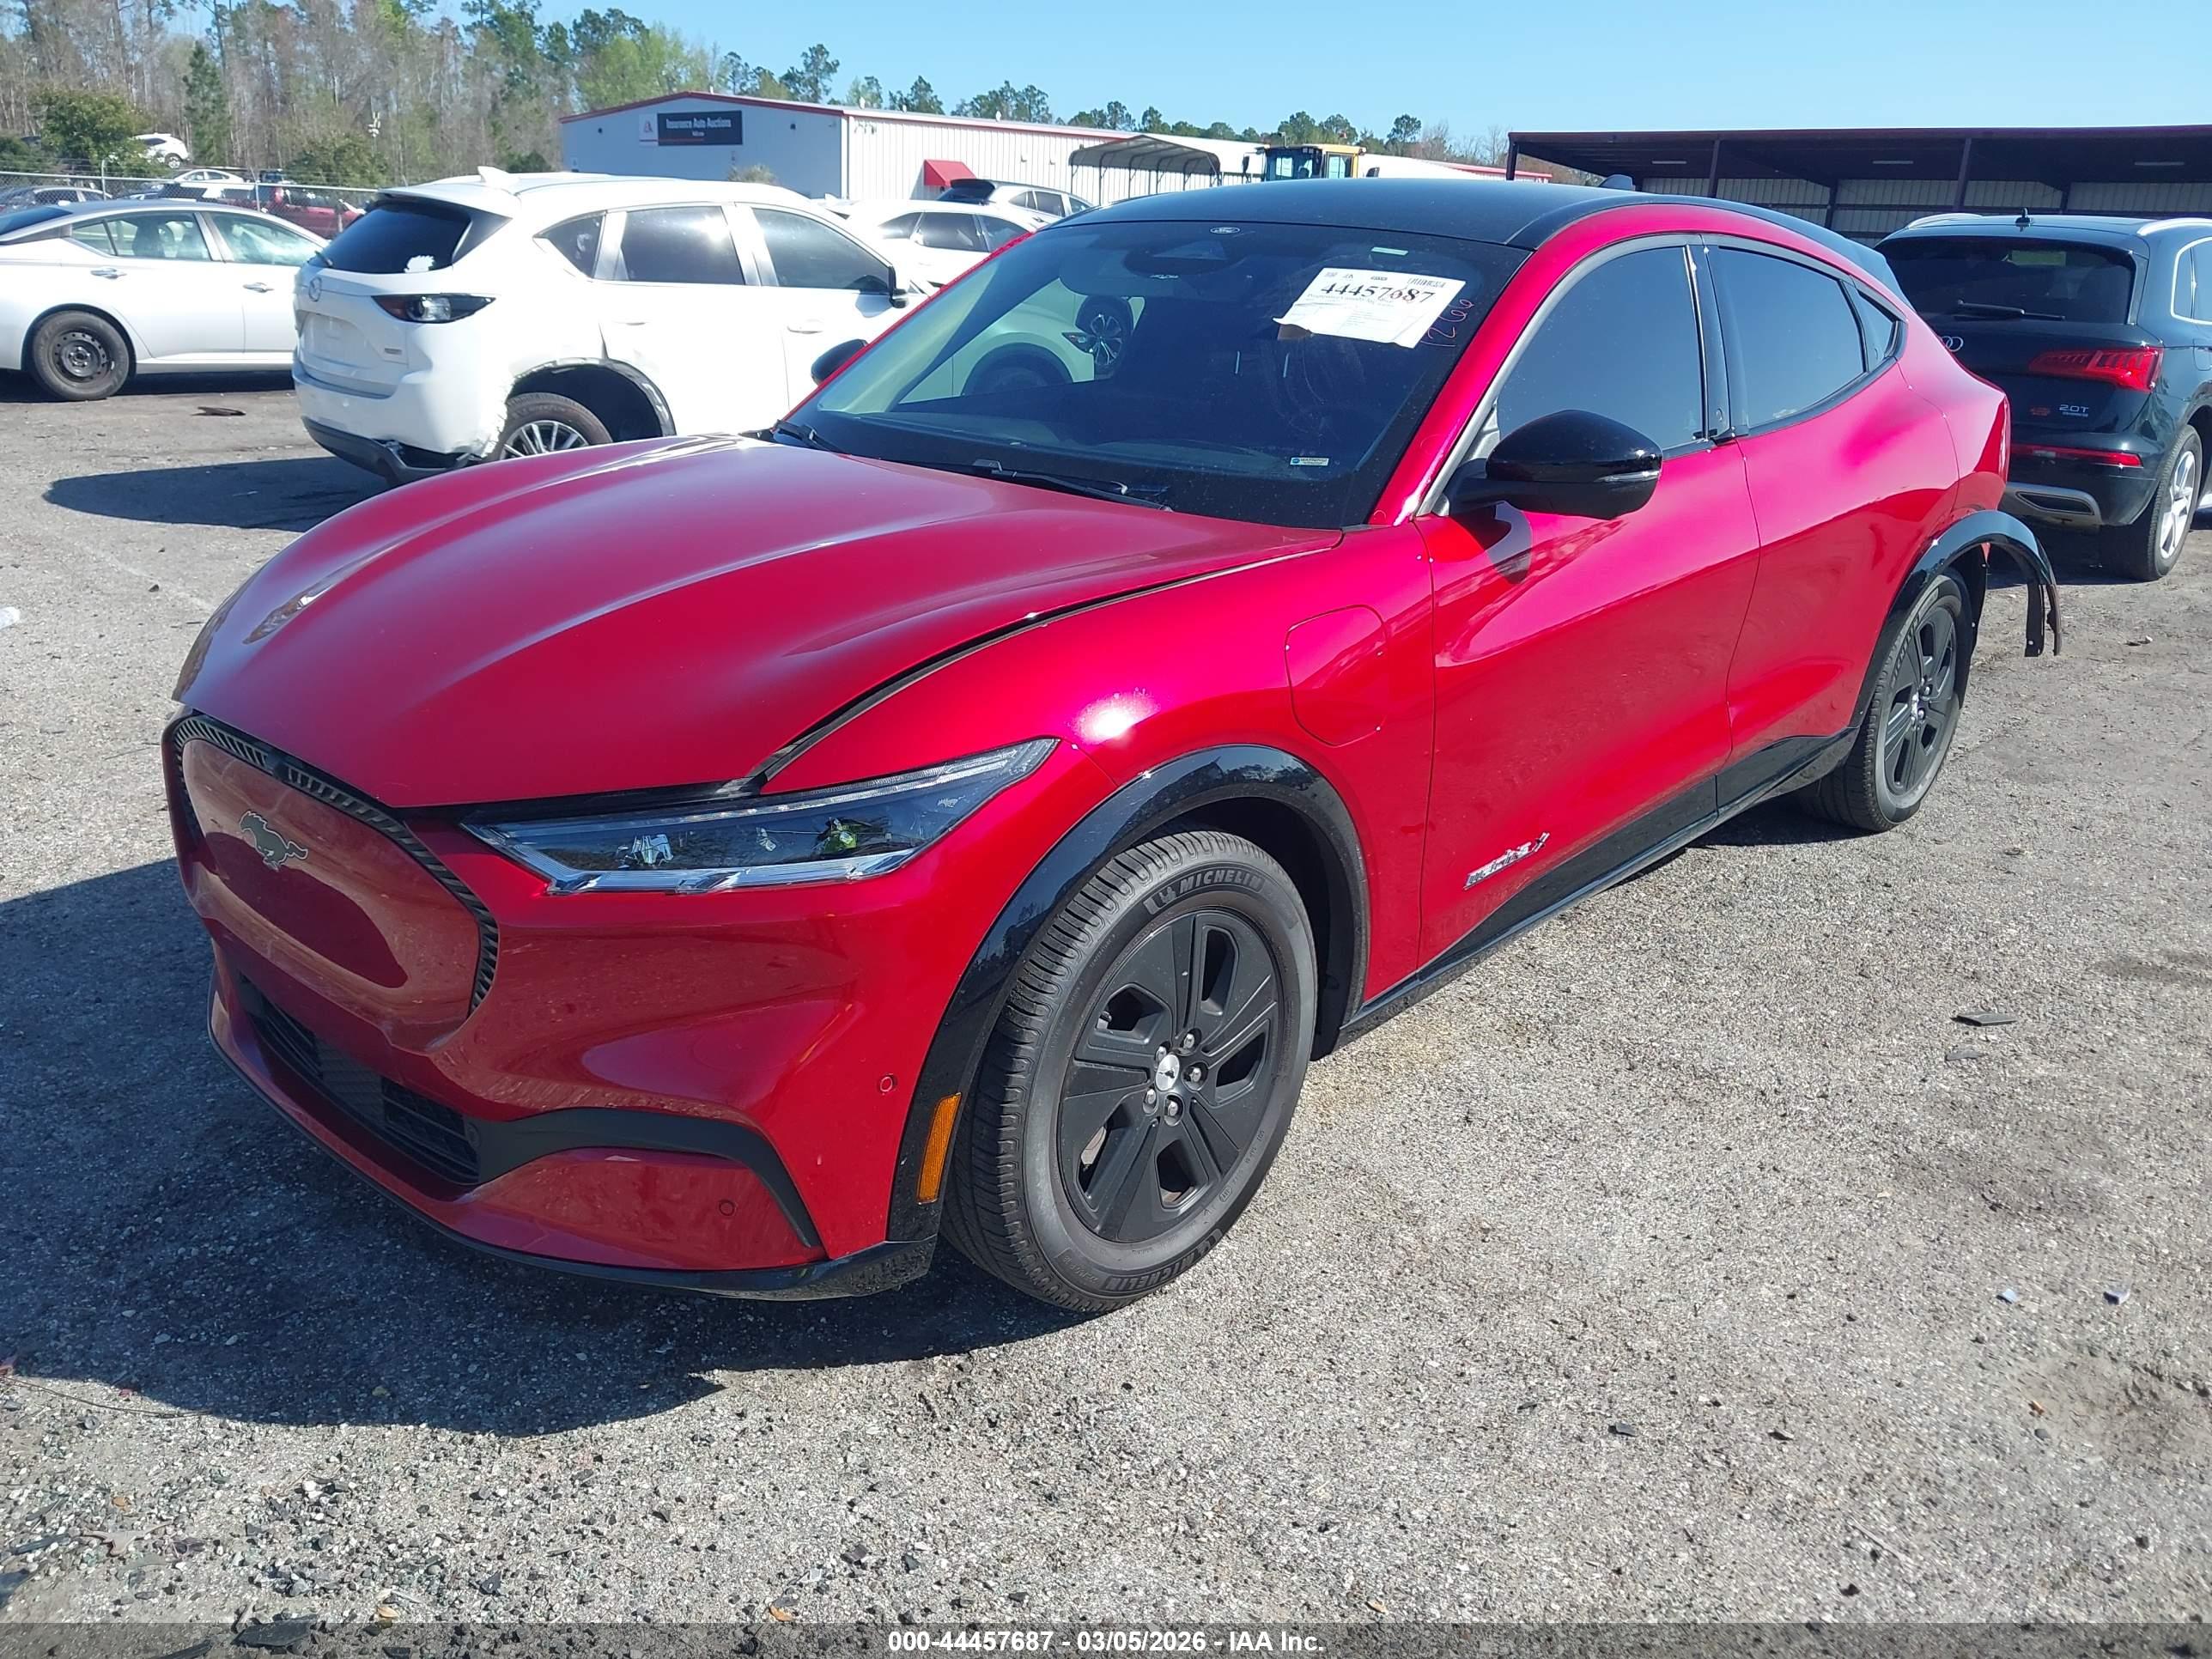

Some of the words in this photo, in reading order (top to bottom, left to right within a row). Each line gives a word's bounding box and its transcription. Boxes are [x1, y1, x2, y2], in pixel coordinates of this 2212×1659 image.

[693, 117, 706, 129] Auto
[1321, 283, 1435, 303] 44457687
[1179, 869, 1265, 894] MICHELIN
